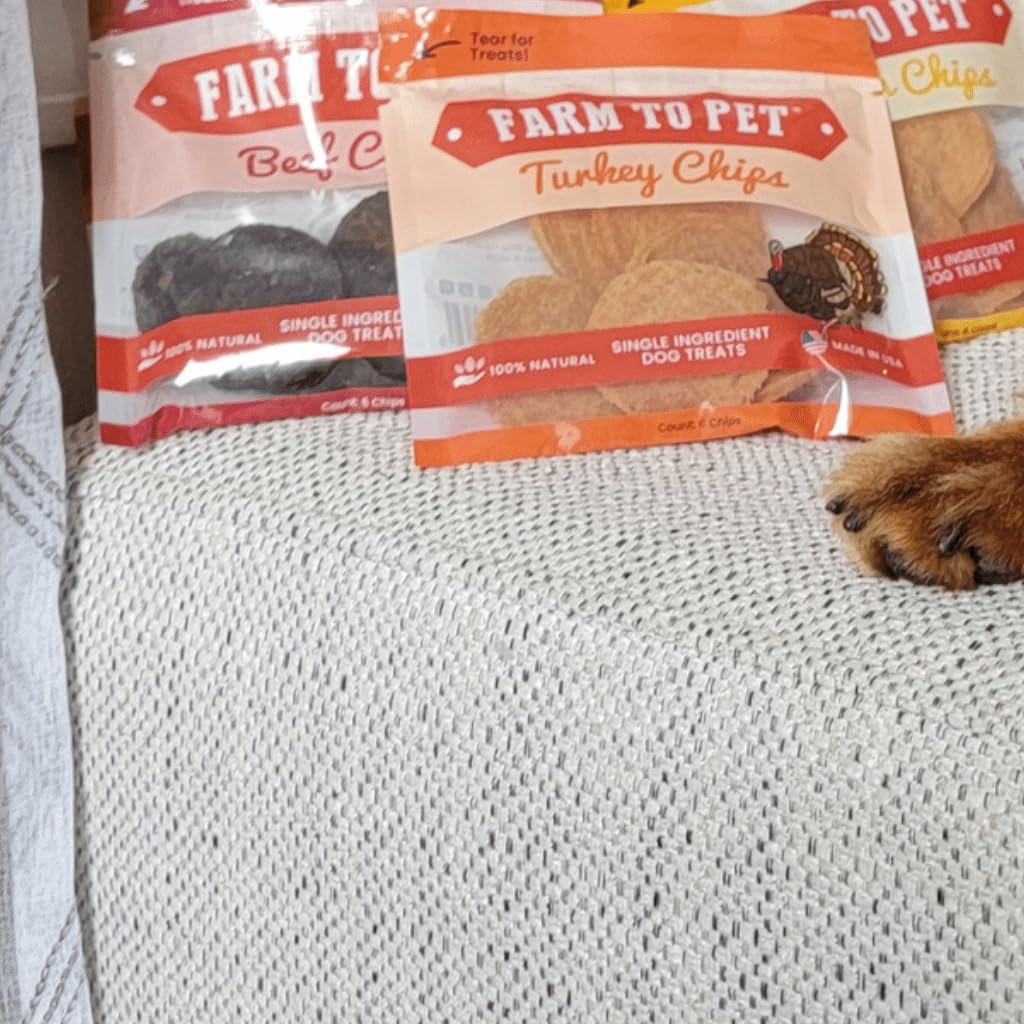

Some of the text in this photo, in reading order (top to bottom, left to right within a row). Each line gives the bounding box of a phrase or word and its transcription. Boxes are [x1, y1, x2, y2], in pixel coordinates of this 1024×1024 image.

[470, 32, 535, 47] Tear for
[470, 47, 530, 62] Treats!
[193, 50, 325, 122] FARM
[901, 52, 998, 102] Chips
[487, 100, 624, 143] FARM
[630, 101, 693, 131] TO
[237, 130, 339, 182] Beef
[519, 148, 790, 199] Turkey Chips
[943, 238, 1017, 266] INGREDIENT
[955, 257, 1003, 280] TREATS
[279, 313, 338, 334] SINGLE
[307, 325, 403, 344] DOG TREAT
[195, 332, 263, 352] NATURAL
[610, 326, 771, 354] SINGLE INGREDIENT
[831, 340, 865, 357] MADE
[489, 353, 596, 377] 100% NATURAL
[641, 343, 747, 366] DOG TREATS
